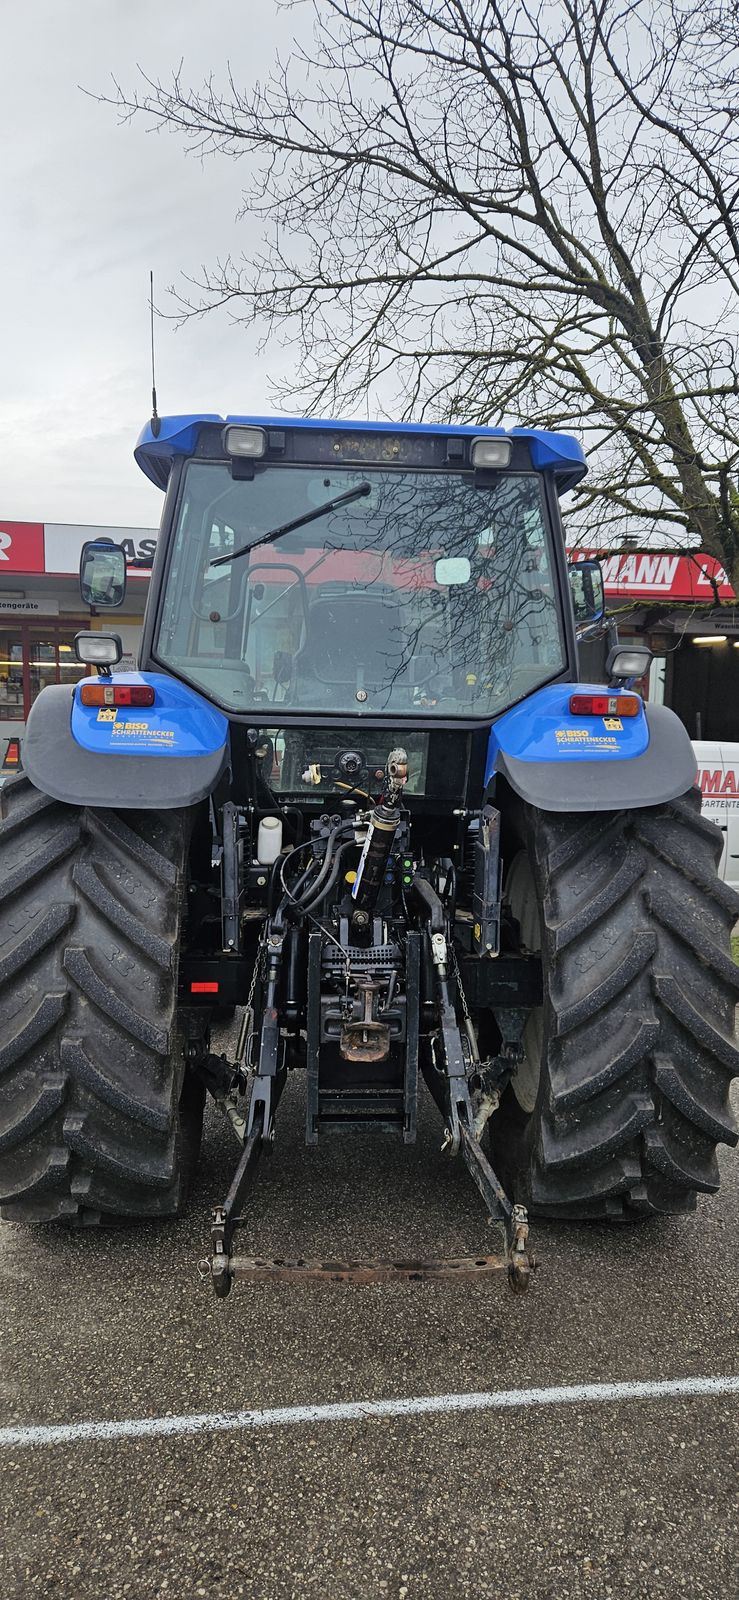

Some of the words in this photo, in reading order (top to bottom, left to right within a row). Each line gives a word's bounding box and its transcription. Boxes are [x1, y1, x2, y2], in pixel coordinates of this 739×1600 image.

[94, 537, 157, 559] AS
[111, 729, 175, 737] SCHRATTENECKER
[125, 722, 149, 730] BISO
[694, 770, 739, 792] MA
